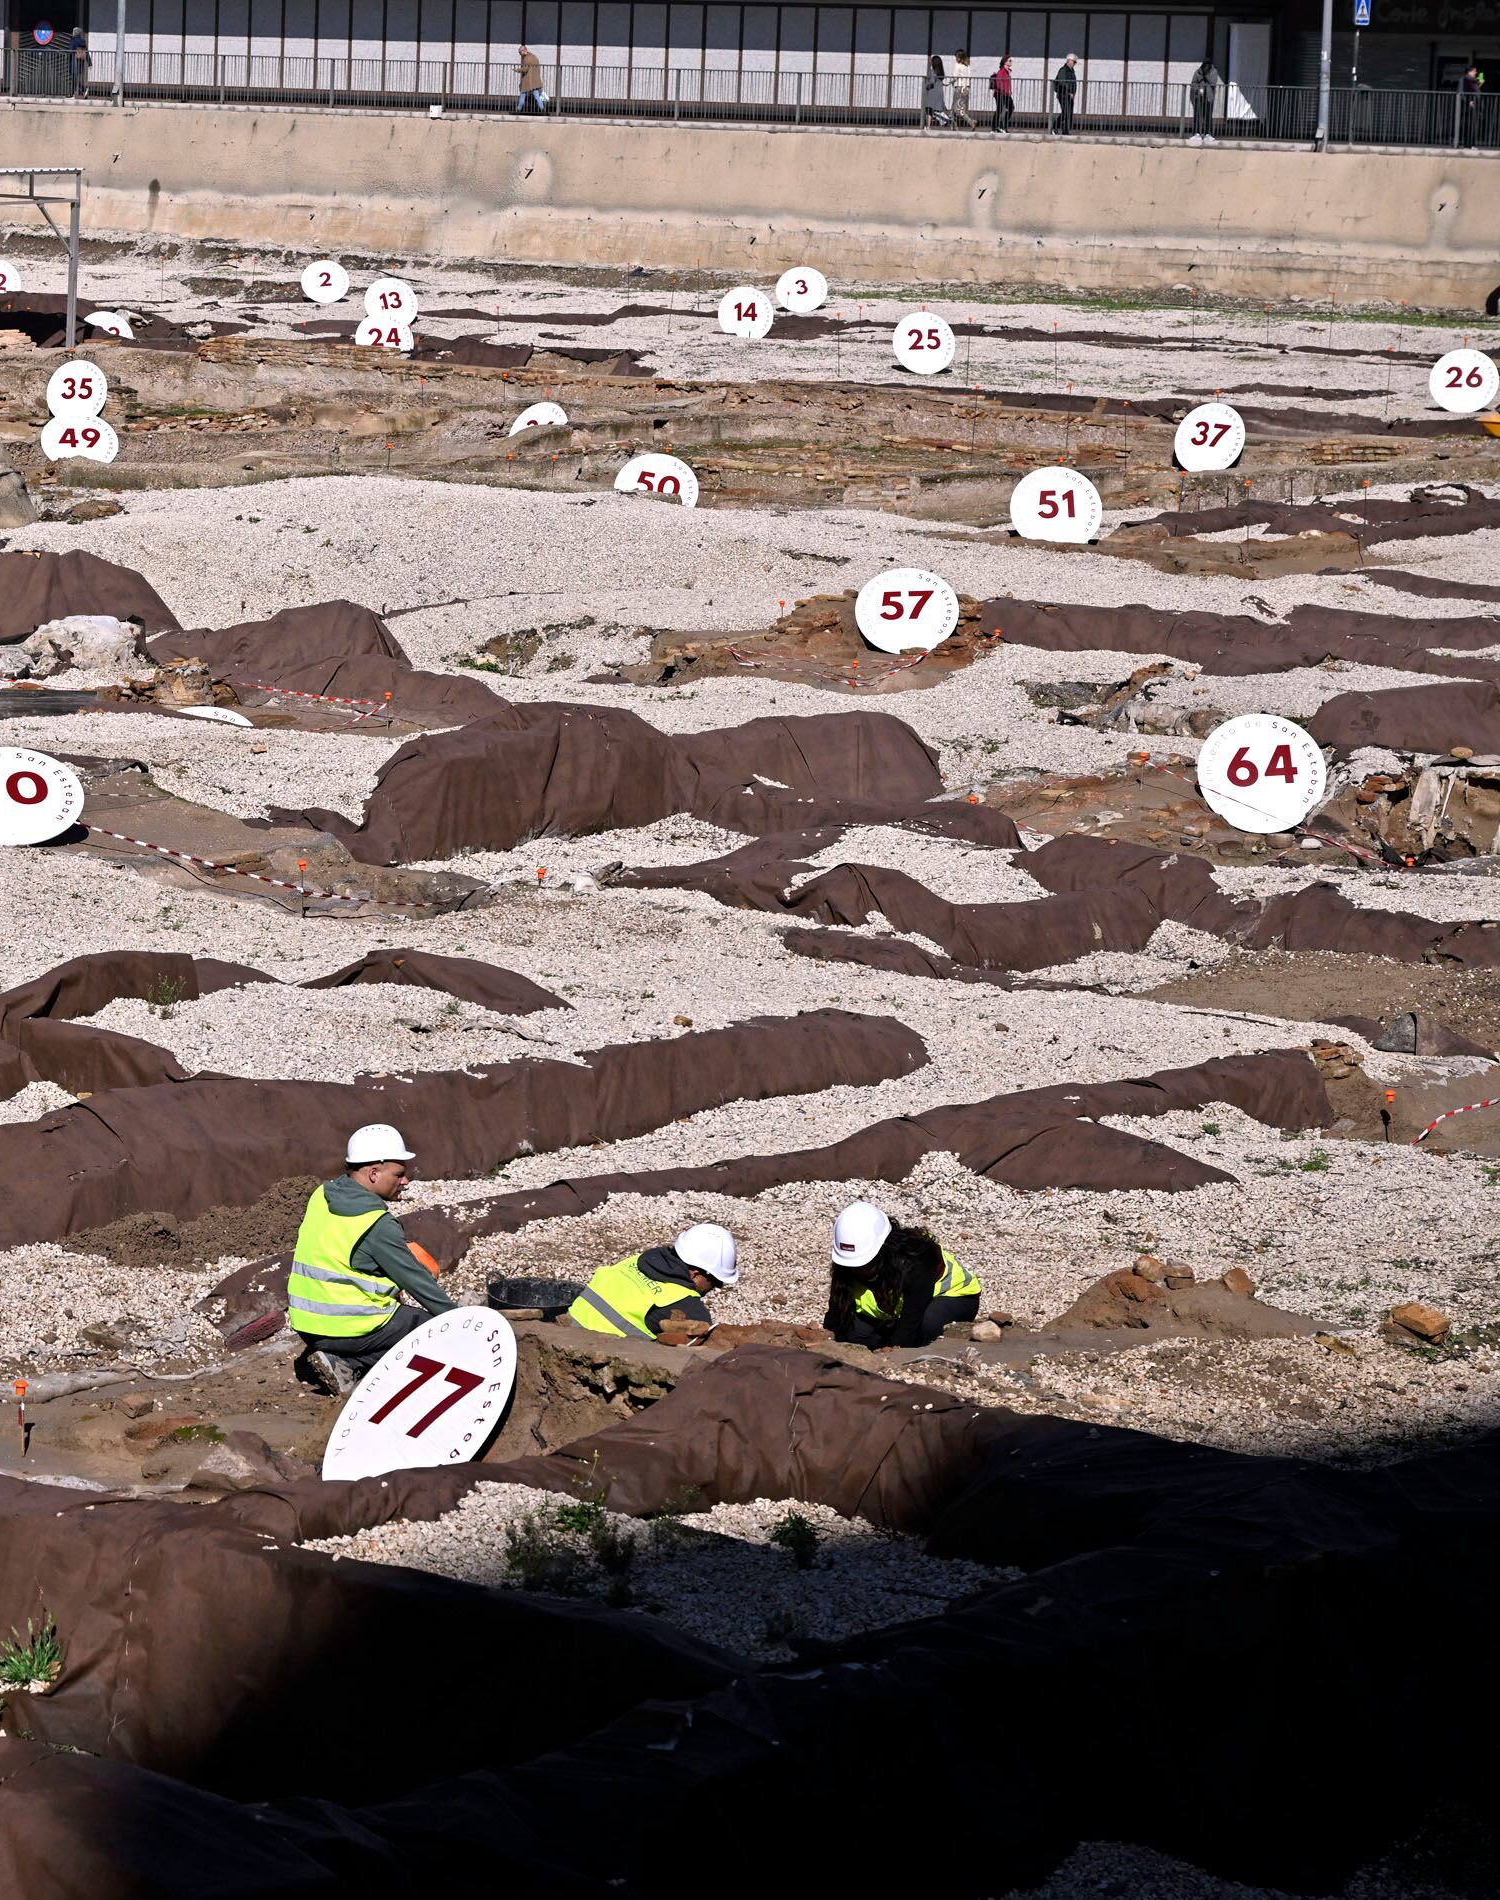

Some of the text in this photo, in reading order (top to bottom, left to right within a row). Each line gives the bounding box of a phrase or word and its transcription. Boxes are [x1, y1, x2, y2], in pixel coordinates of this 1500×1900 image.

[319, 272, 332, 287] 2
[795, 279, 808, 295] 3
[379, 292, 403, 310] 13
[734, 302, 758, 321] 14
[368, 328, 401, 347] 24
[908, 329, 941, 350] 25
[61, 377, 93, 400] 35
[1445, 366, 1483, 388] 26
[58, 428, 101, 448] 49
[1191, 421, 1232, 447] 37
[637, 471, 681, 495] 50
[1038, 490, 1075, 519] 51
[880, 591, 934, 620] 57
[1226, 744, 1298, 788] 64
[1272, 721, 1298, 739] San
[1302, 742, 1318, 804] Esteban
[15, 752, 47, 767] San
[53, 769, 75, 821] Esteban
[334, 1322, 449, 1457] Yacimiento
[462, 1316, 483, 1332] de
[487, 1329, 502, 1368] San
[368, 1354, 485, 1439] 77
